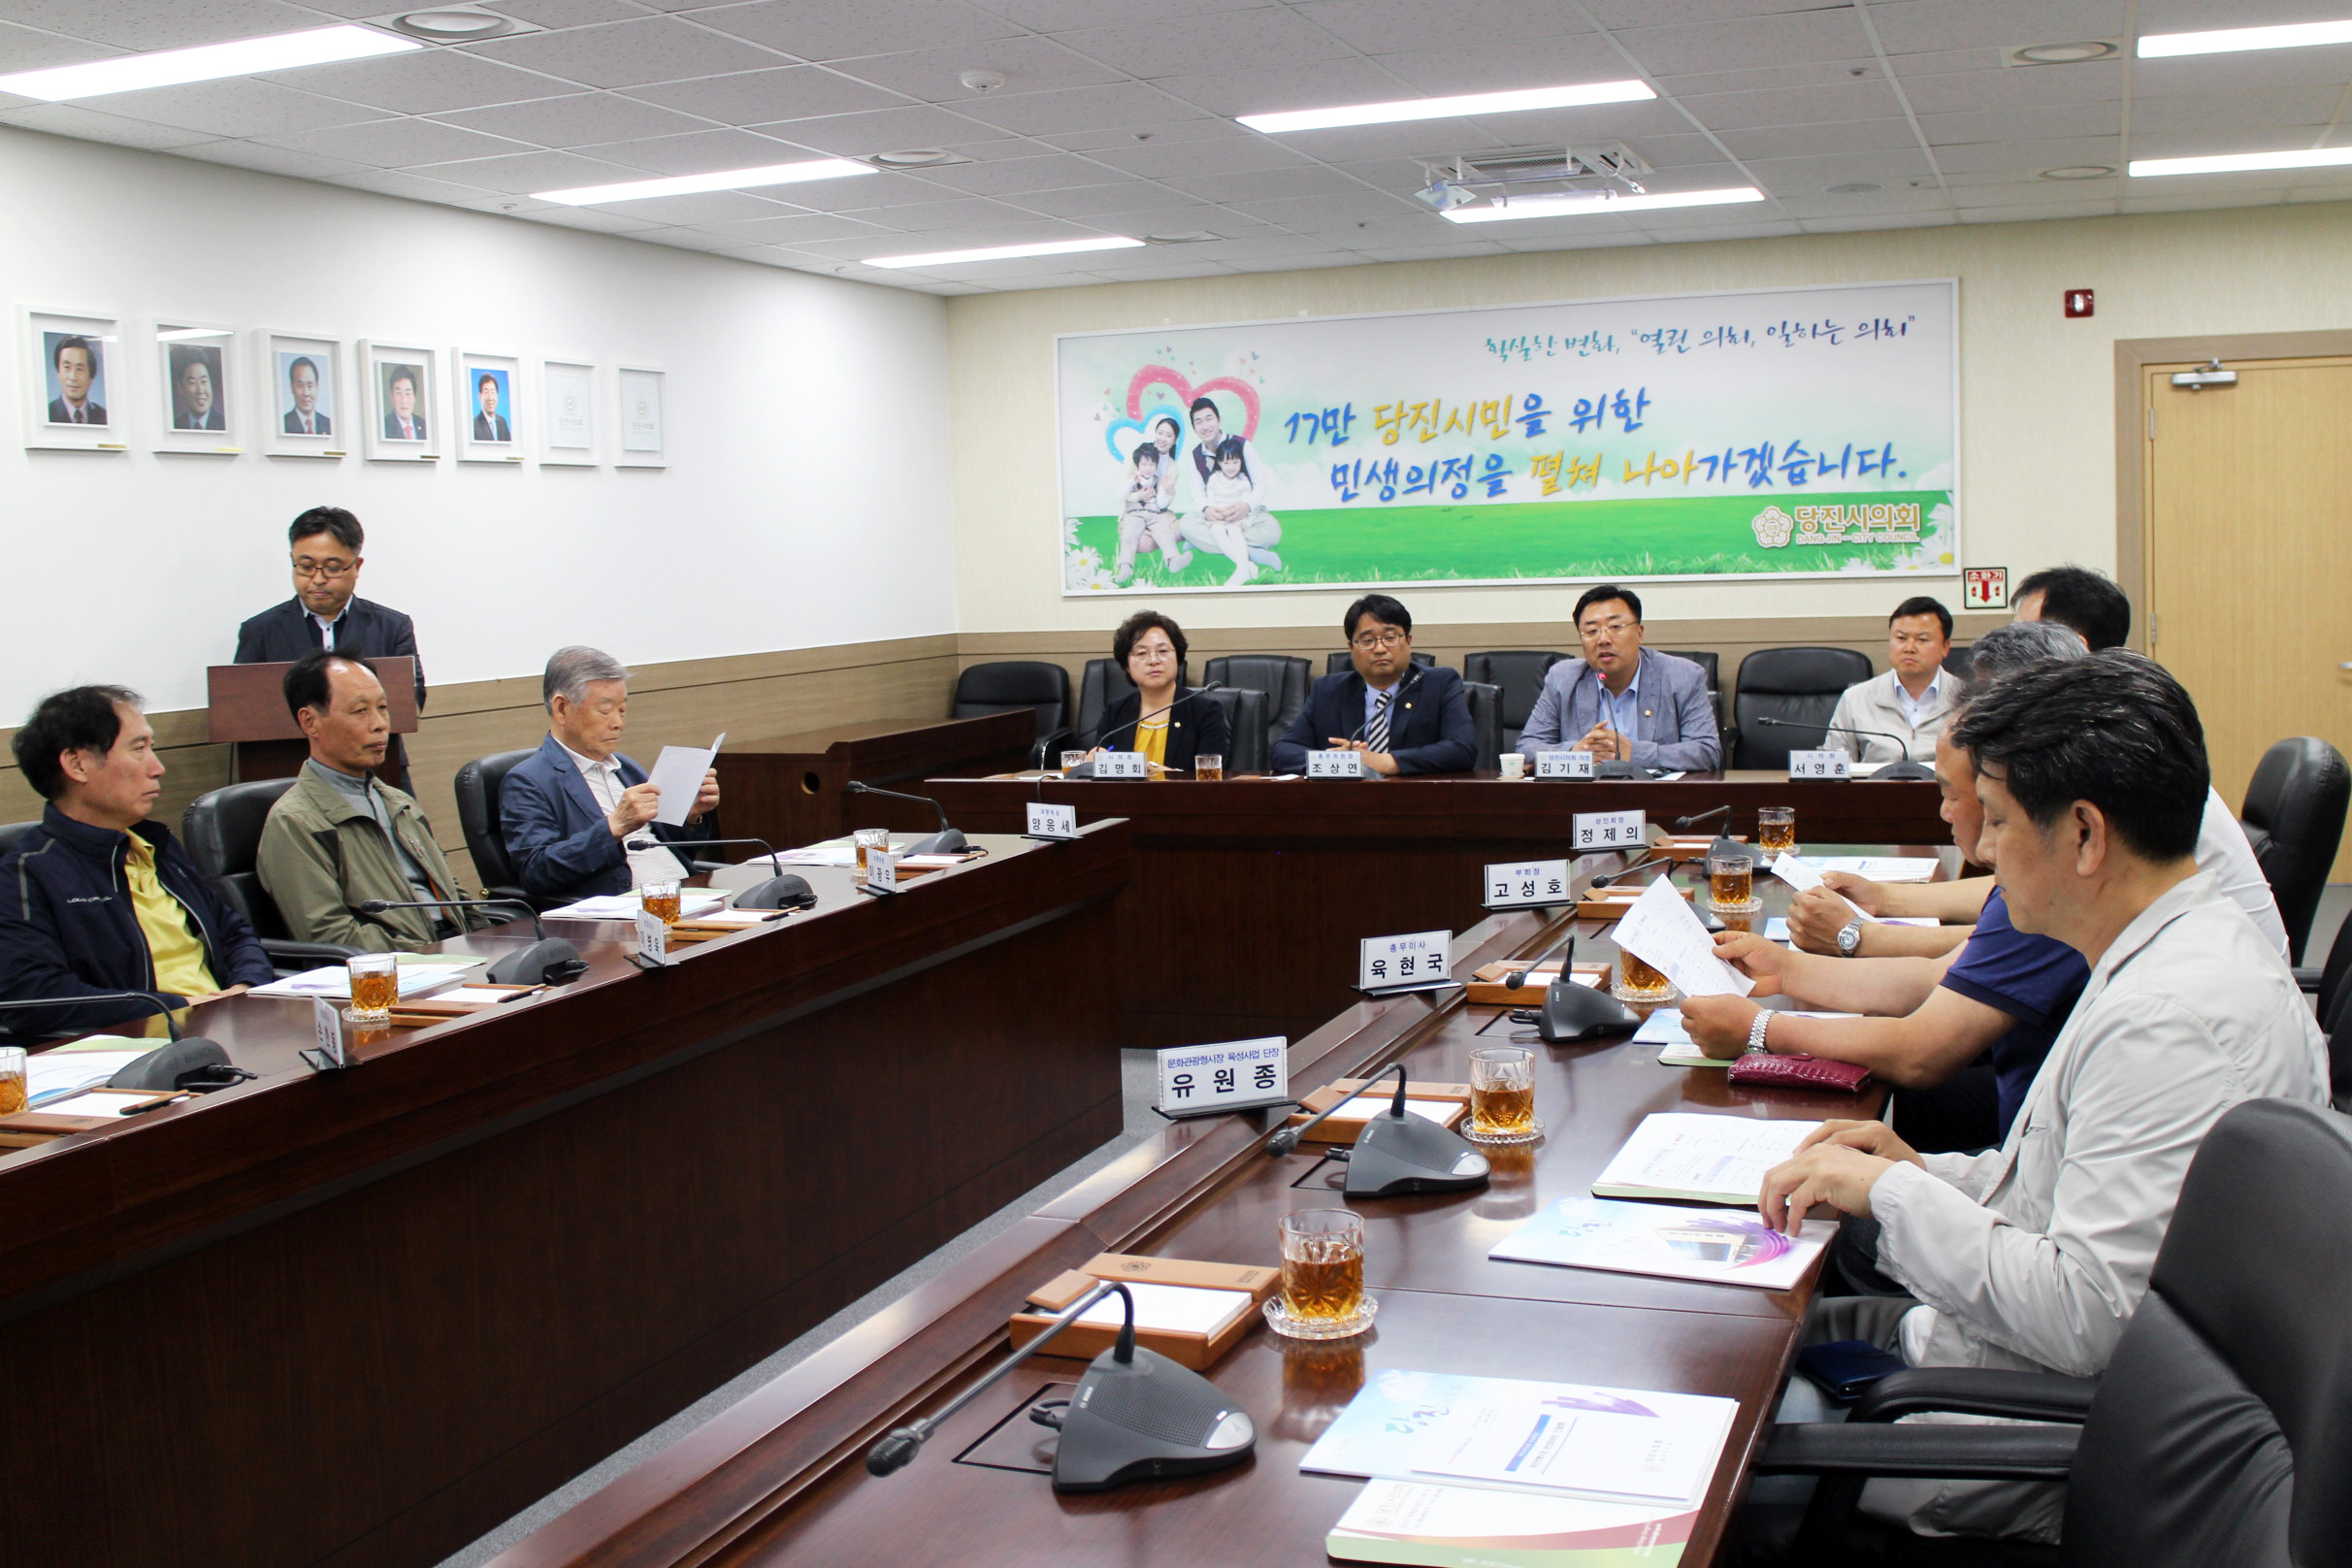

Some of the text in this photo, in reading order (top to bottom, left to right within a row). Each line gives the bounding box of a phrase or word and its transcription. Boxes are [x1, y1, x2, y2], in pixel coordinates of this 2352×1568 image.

[1565, 330, 1619, 357] 변화,
[1699, 326, 1755, 348] 의회,
[1767, 318, 1846, 347] 일하는
[1284, 387, 1651, 446] 17만 당진시민을 위한
[1330, 439, 1908, 503] 민생의정을 펼쳐 나아가겠습니다.
[1795, 504, 1919, 533] 당진시의회
[1797, 533, 1824, 543] DANG
[1826, 533, 1842, 543] JIN
[1851, 532, 1875, 542] CITY
[1876, 531, 1919, 542] COUNCIL
[1389, 940, 1426, 953] 총무이사
[1167, 1047, 1280, 1068] 문화관광형시장 육성사업 단장
